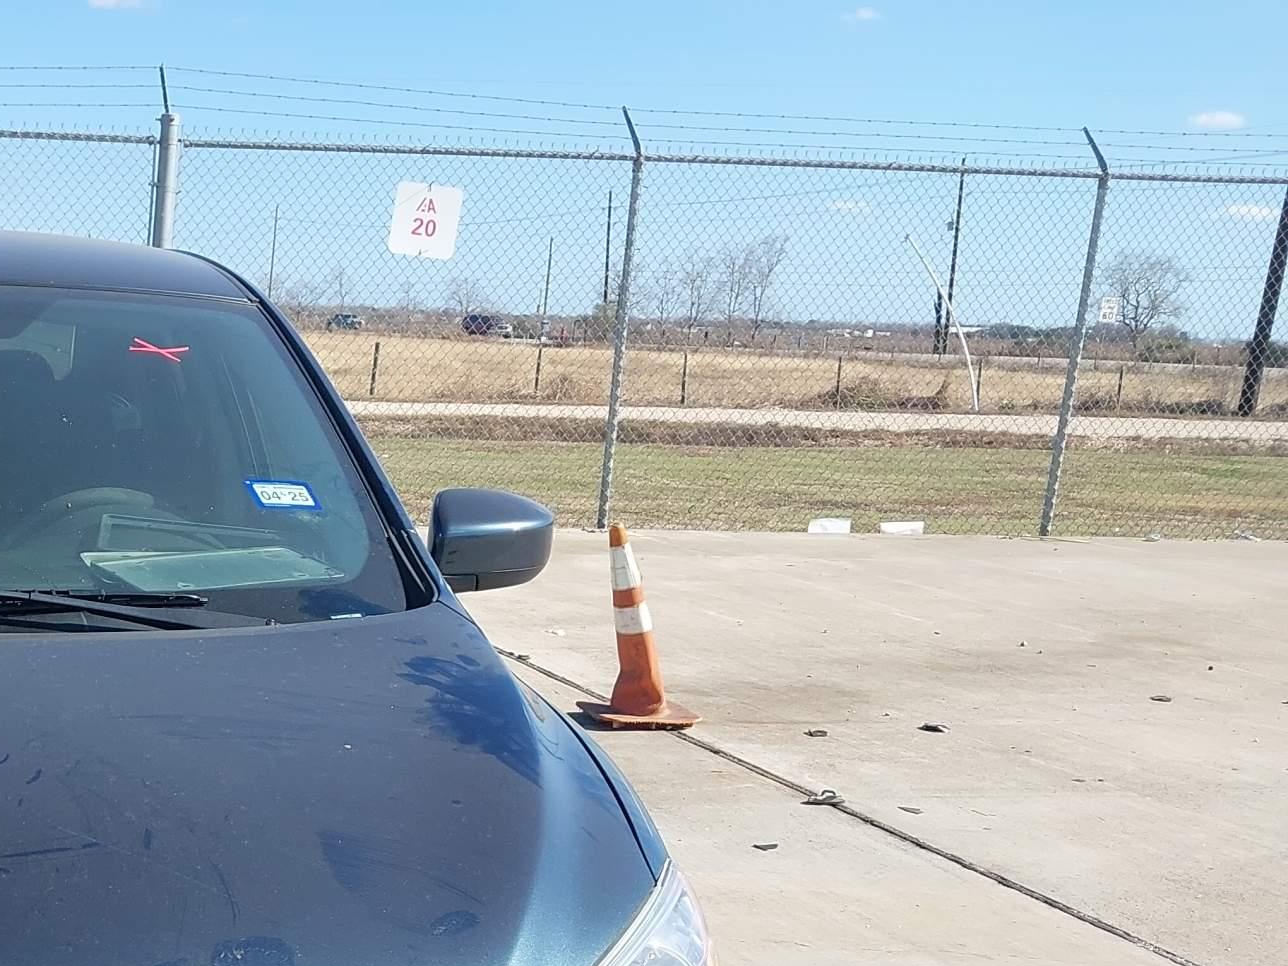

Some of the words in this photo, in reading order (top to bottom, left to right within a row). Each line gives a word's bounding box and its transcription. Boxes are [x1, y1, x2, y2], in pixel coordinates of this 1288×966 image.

[411, 217, 437, 237] 20
[260, 490, 281, 501] 04
[287, 491, 309, 502] 25
